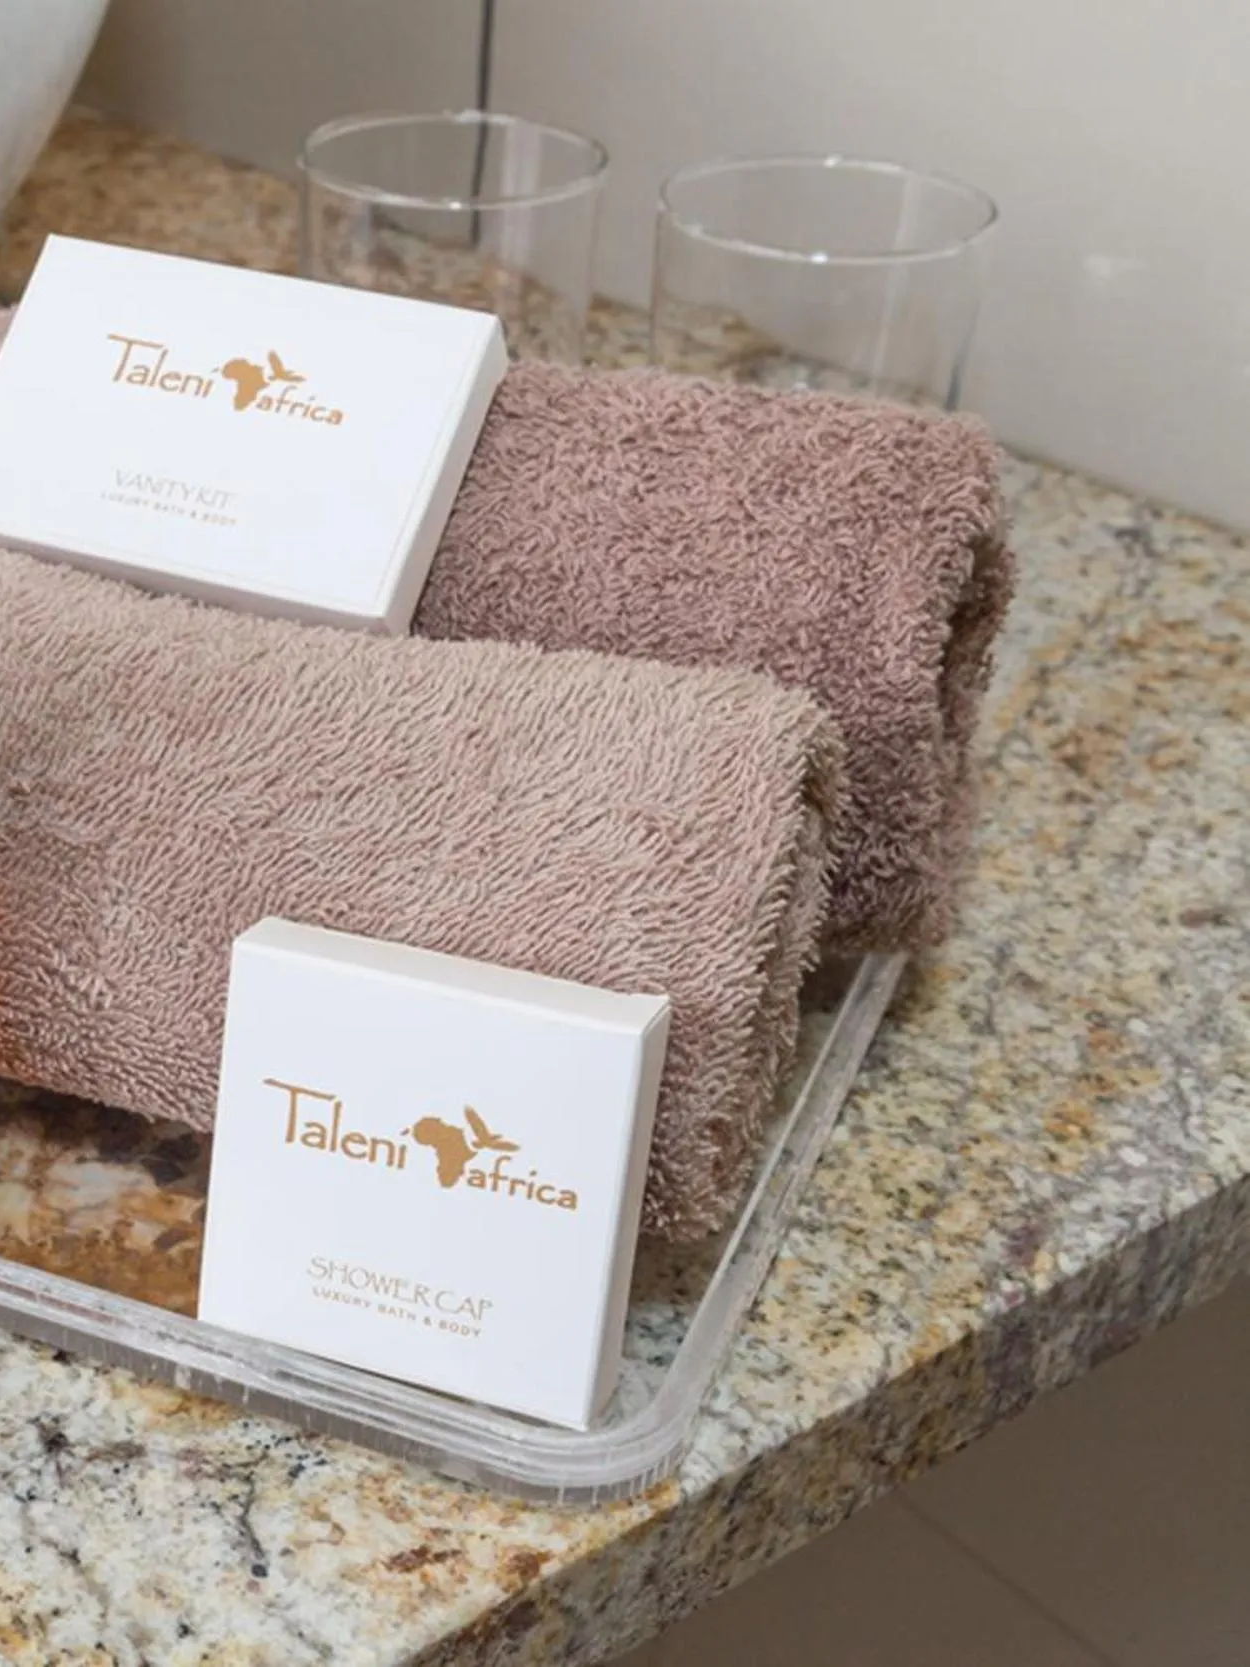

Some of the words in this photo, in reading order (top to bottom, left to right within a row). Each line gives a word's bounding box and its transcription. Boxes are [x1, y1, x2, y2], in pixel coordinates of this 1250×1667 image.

[106, 333, 218, 399] Taleni
[254, 386, 345, 427] africa
[263, 1077, 412, 1170] Taleni
[466, 1155, 579, 1211] africa
[306, 1255, 431, 1307] SHOWER
[434, 1289, 495, 1321] CAP
[312, 1286, 371, 1308] LUXURY
[377, 1303, 417, 1322] BATH
[423, 1316, 432, 1326] &
[438, 1320, 481, 1338] BODY
